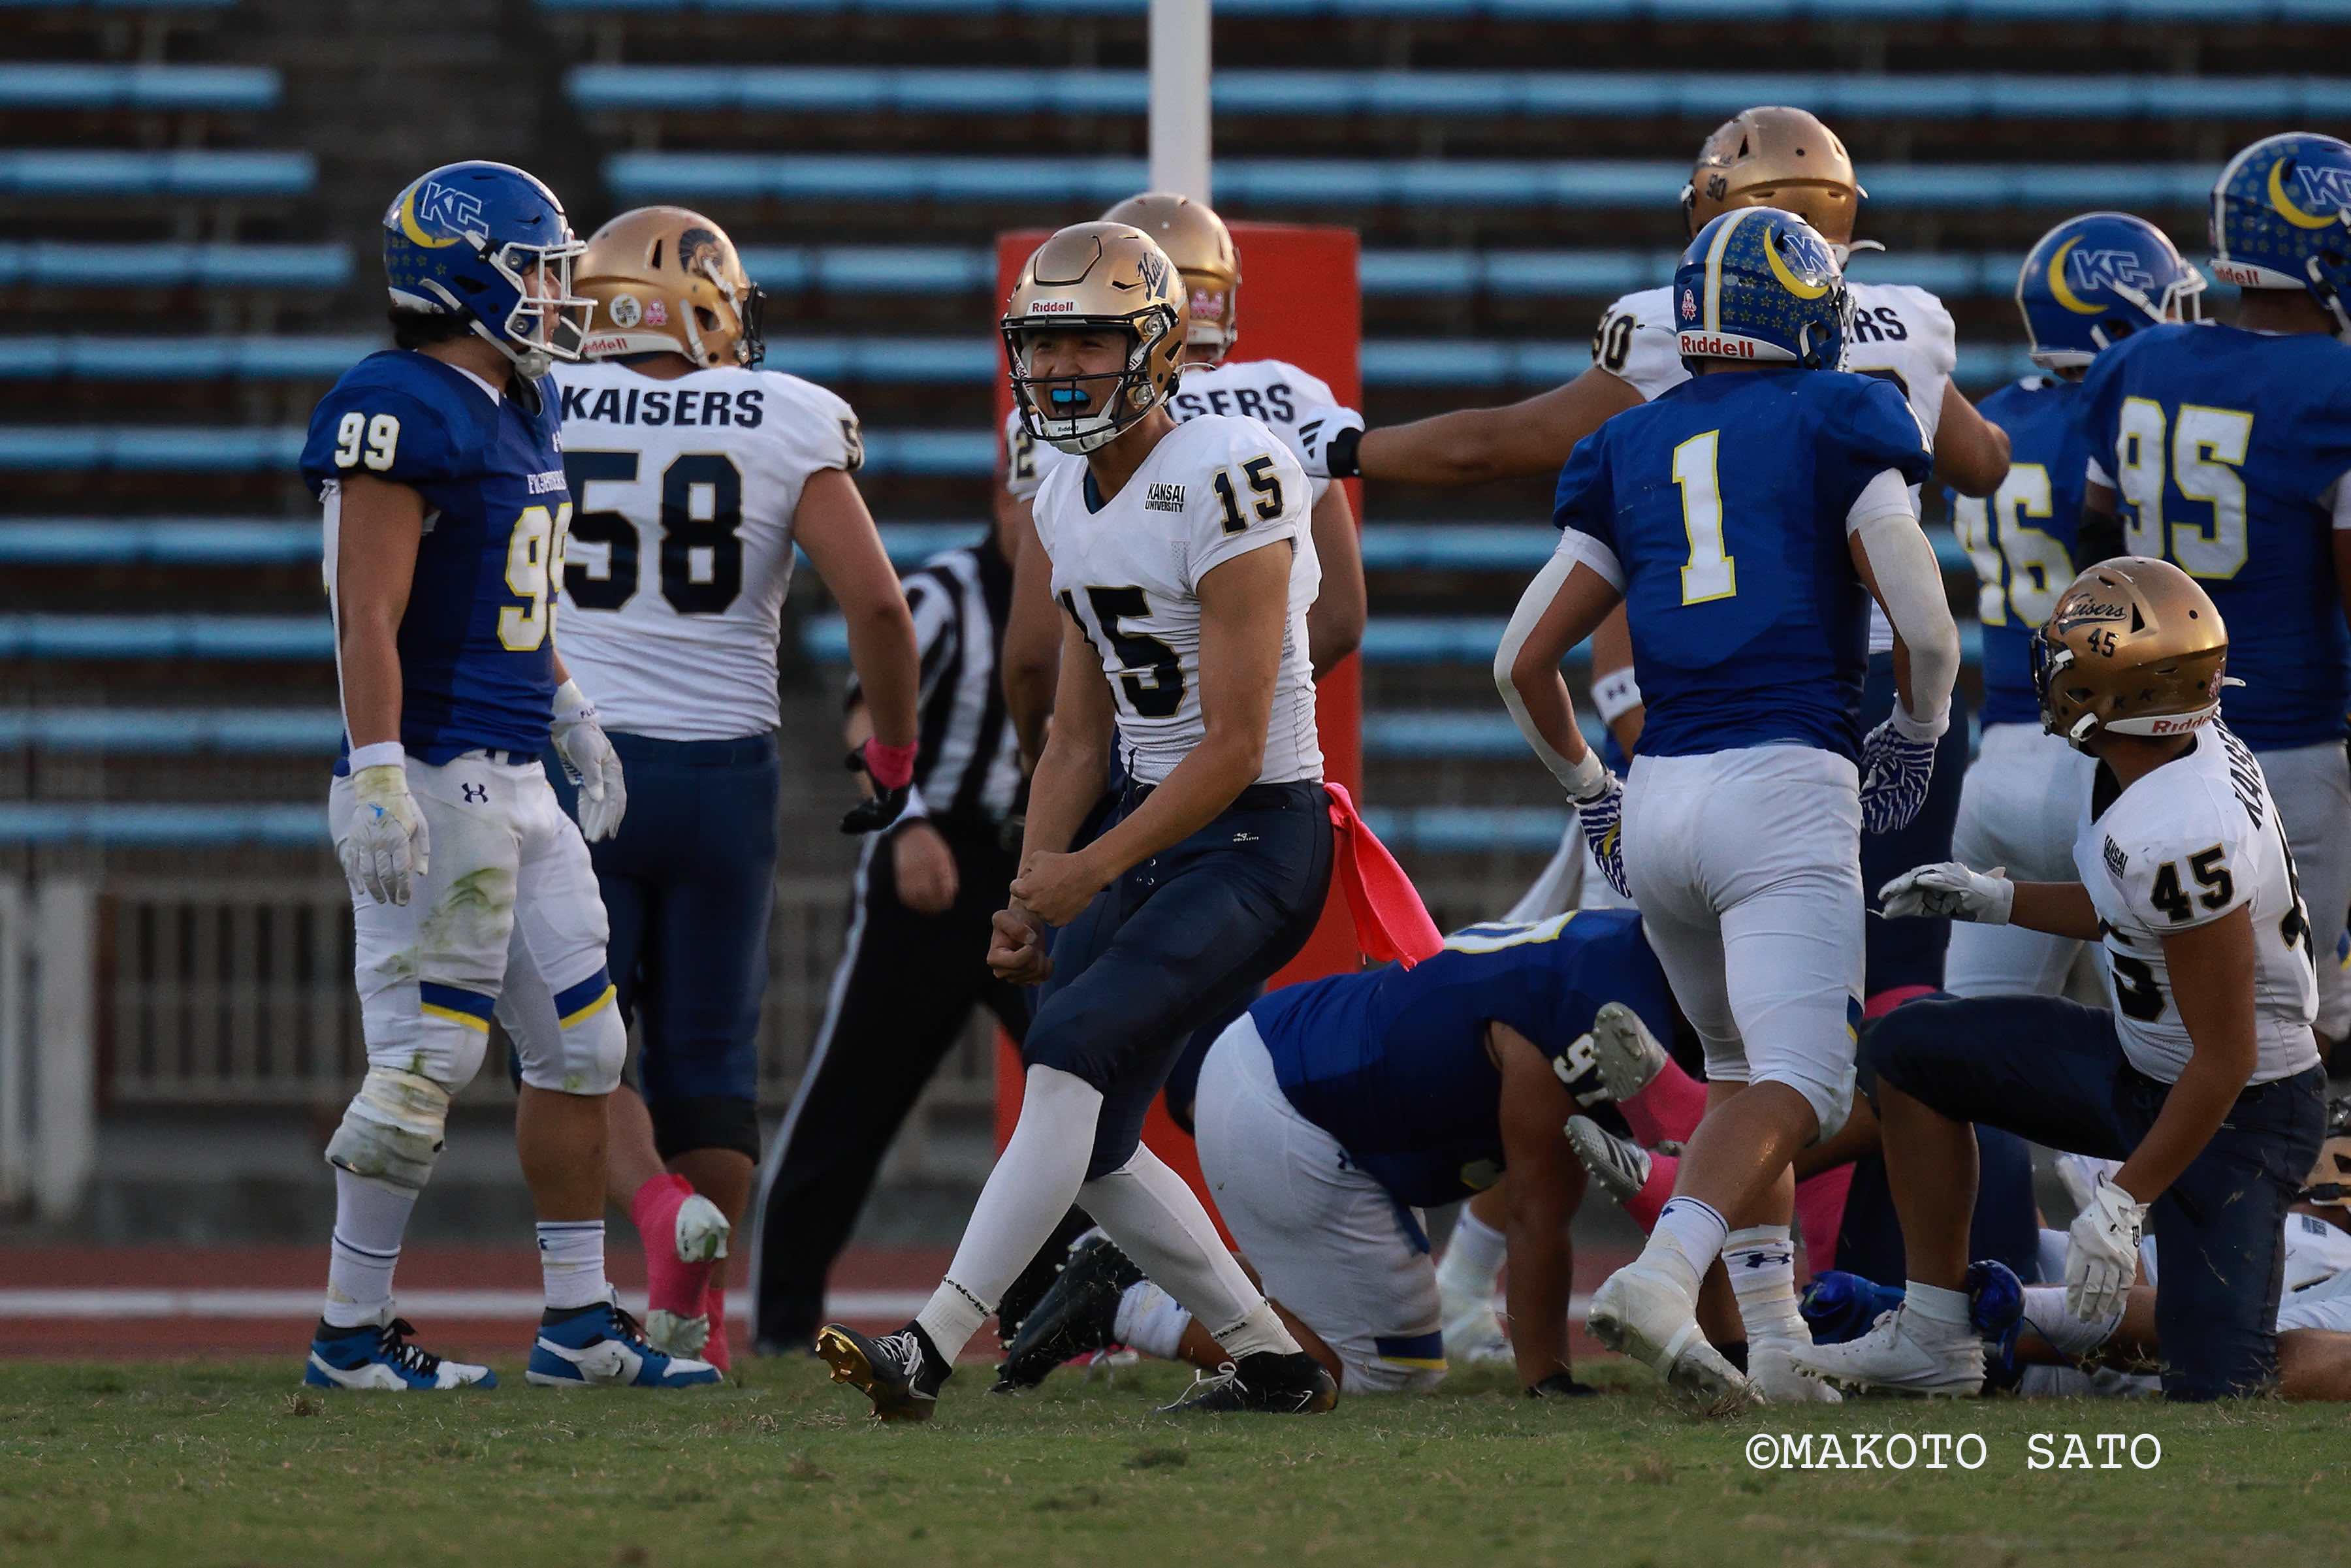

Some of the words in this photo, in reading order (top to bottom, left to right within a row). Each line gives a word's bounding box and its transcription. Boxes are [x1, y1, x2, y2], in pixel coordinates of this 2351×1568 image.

[1032, 302, 1074, 312] Riddell
[1682, 335, 1754, 358] Riddell
[561, 385, 764, 429] KAISERS
[334, 411, 400, 472] 99
[1144, 500, 1184, 513] UNIVERSITY
[1147, 483, 1186, 502] KANSAI
[1211, 453, 1285, 536] 15
[2115, 395, 2254, 580] 95
[562, 449, 743, 618] 58
[1672, 428, 1737, 606] 1
[2087, 628, 2120, 658] 45
[2150, 842, 2235, 924] 45
